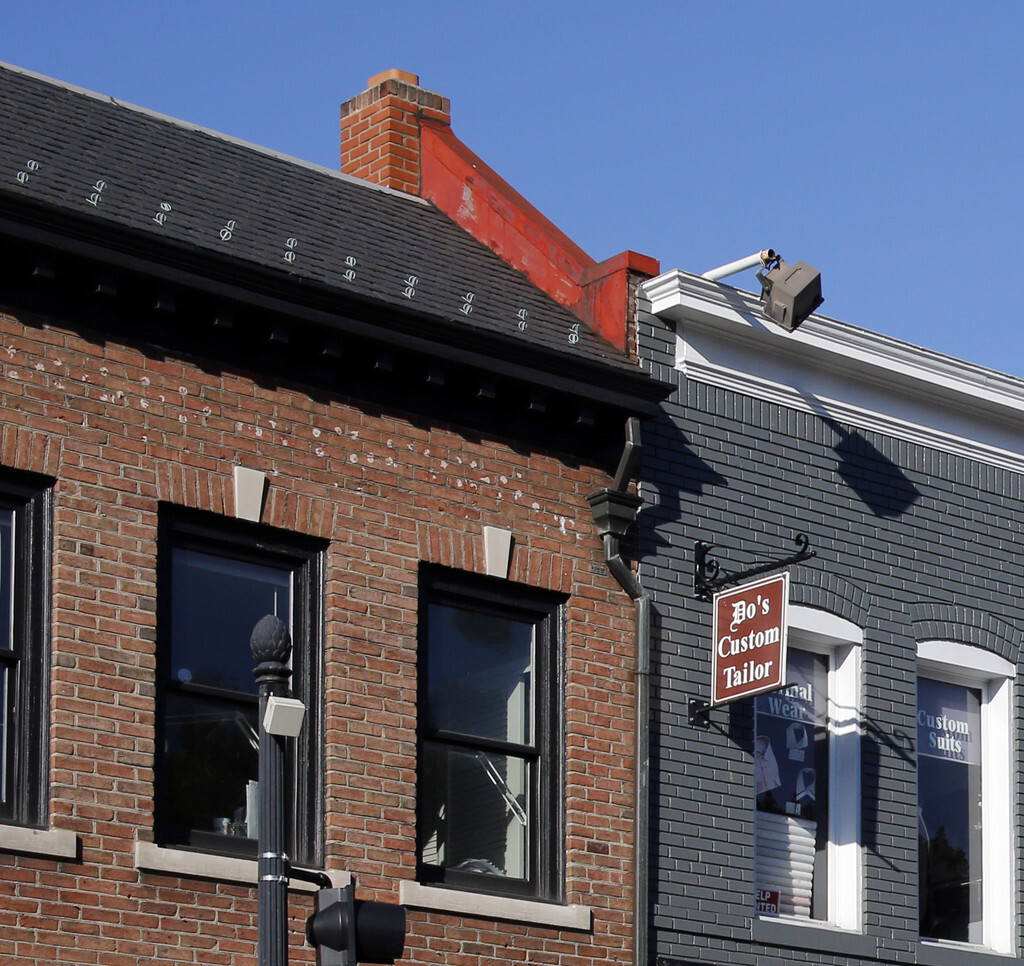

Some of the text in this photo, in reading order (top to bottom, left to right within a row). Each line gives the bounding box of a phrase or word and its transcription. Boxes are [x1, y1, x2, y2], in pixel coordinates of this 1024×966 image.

[729, 594, 770, 632] Do's
[718, 626, 780, 658] Custom
[723, 660, 773, 689] Tailor
[768, 697, 806, 720] Wear
[918, 710, 969, 735] Custom
[929, 731, 962, 753] Suits
[756, 889, 771, 901] ELP
